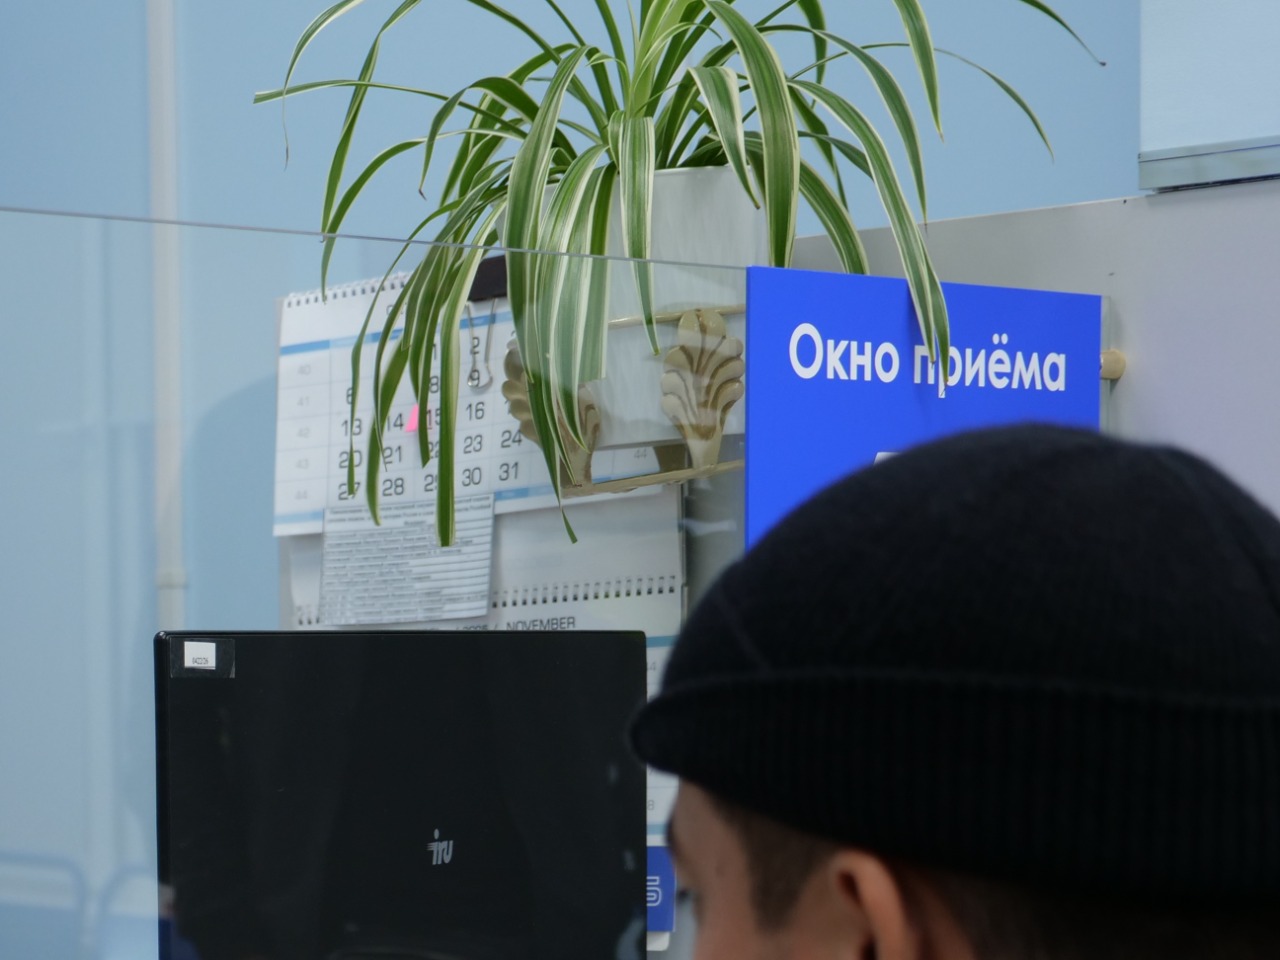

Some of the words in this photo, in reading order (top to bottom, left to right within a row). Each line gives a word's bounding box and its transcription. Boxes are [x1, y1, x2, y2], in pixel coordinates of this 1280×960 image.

[788, 322, 900, 384] Окно
[913, 333, 1067, 399] приёма
[341, 418, 363, 436] 13
[386, 412, 404, 432] 14
[465, 401, 485, 421] 16
[338, 449, 363, 469] 20
[382, 445, 403, 465] 21
[463, 434, 483, 454] 23
[500, 429, 522, 449] 24
[337, 481, 361, 501] 27
[381, 477, 405, 496] 28
[461, 466, 483, 487] 30
[498, 461, 520, 481] 31
[506, 616, 577, 631] NOVEMBER
